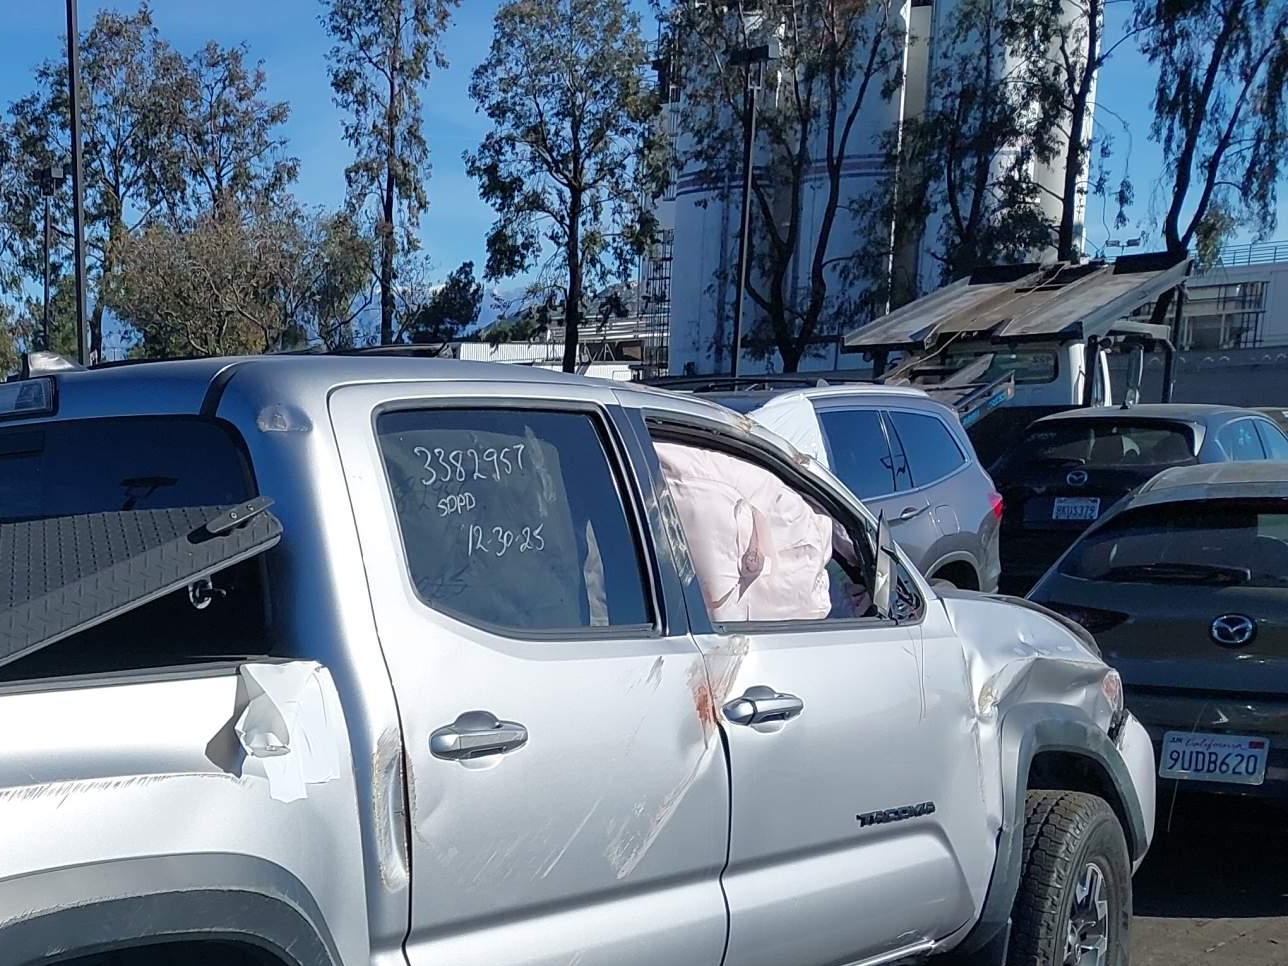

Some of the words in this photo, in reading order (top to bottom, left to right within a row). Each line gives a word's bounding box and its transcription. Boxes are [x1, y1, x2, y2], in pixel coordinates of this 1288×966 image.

[414, 444, 524, 485] 3382957
[1167, 750, 1258, 776] 9UDB620
[856, 801, 935, 827] TACOMA
